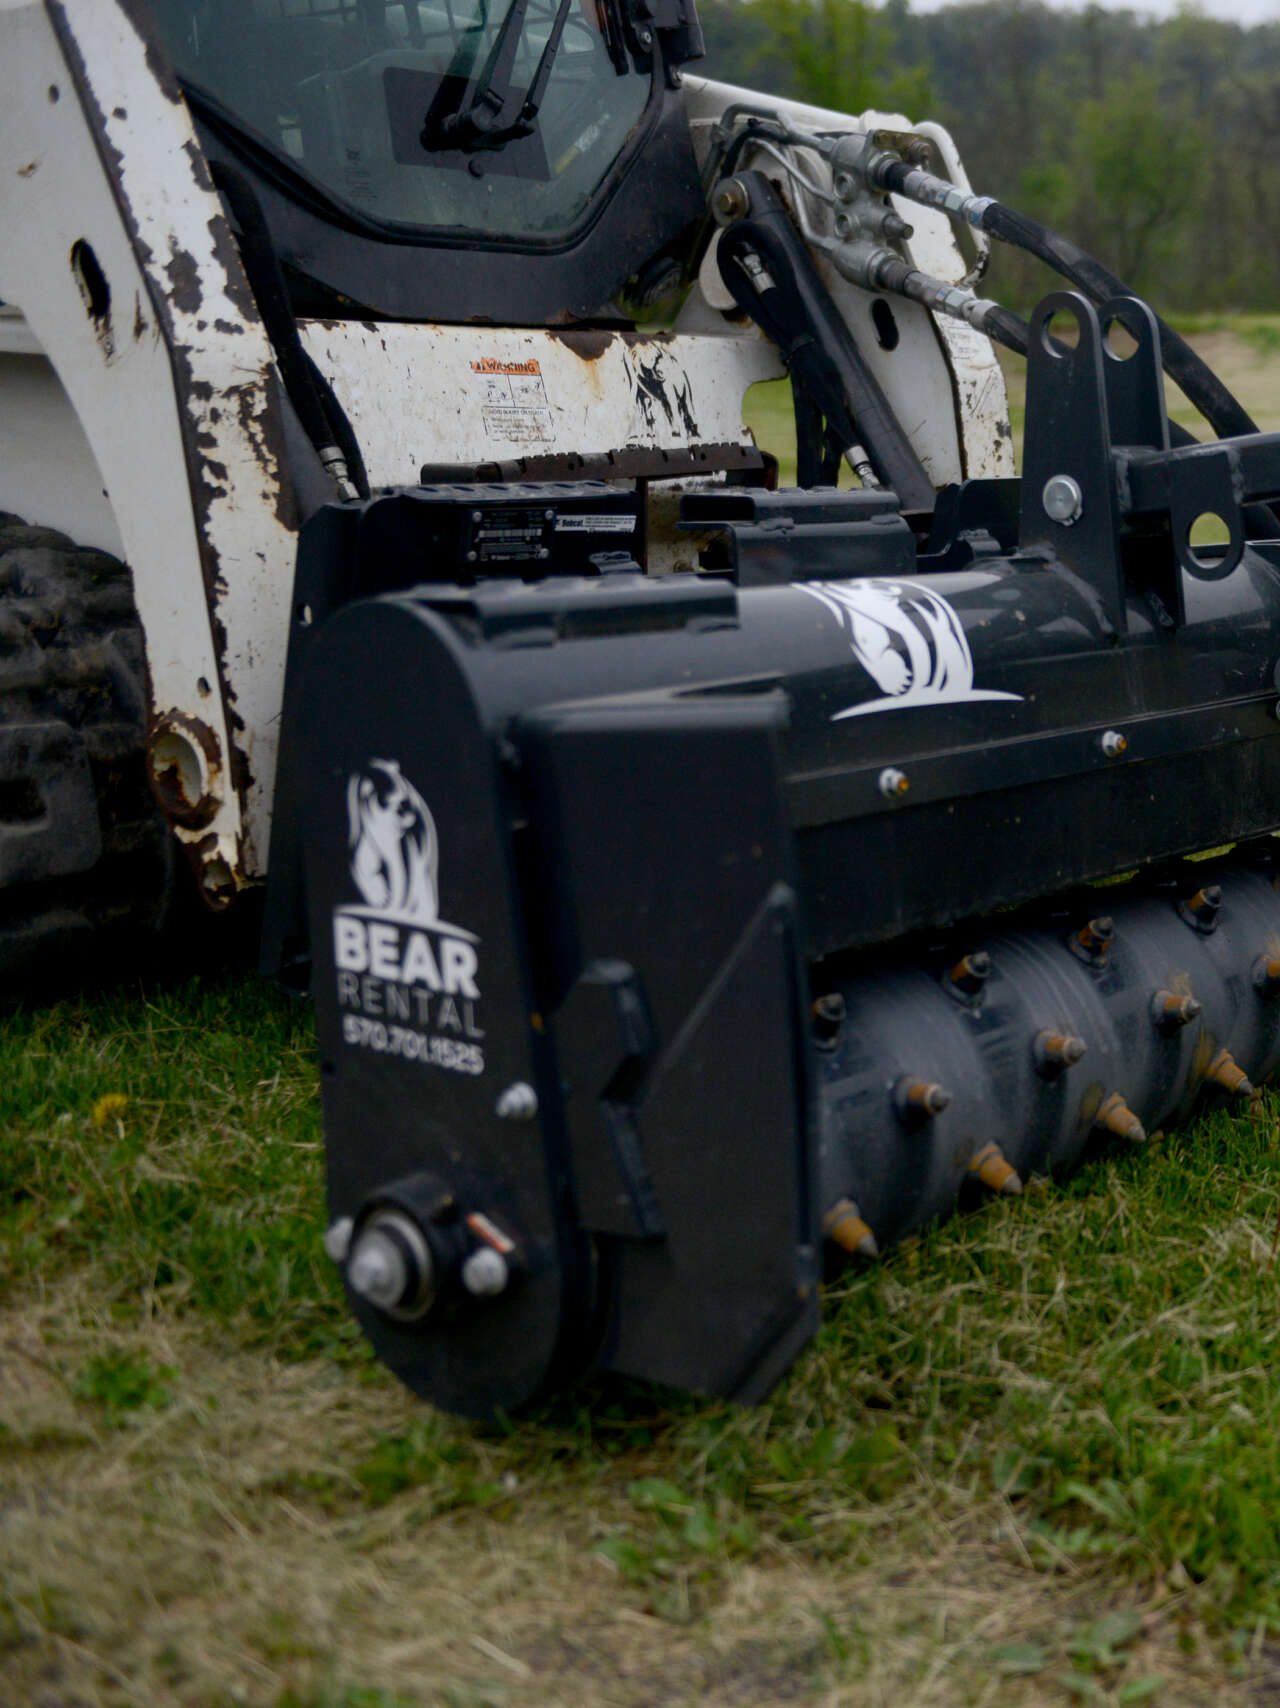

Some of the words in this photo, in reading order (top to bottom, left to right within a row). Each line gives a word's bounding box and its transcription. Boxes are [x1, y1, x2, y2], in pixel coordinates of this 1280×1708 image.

[561, 519, 584, 529] Bobcat
[334, 916, 481, 999] BEAR
[337, 972, 487, 1039] RENTAL
[342, 1013, 485, 1076] 570.701.1525
